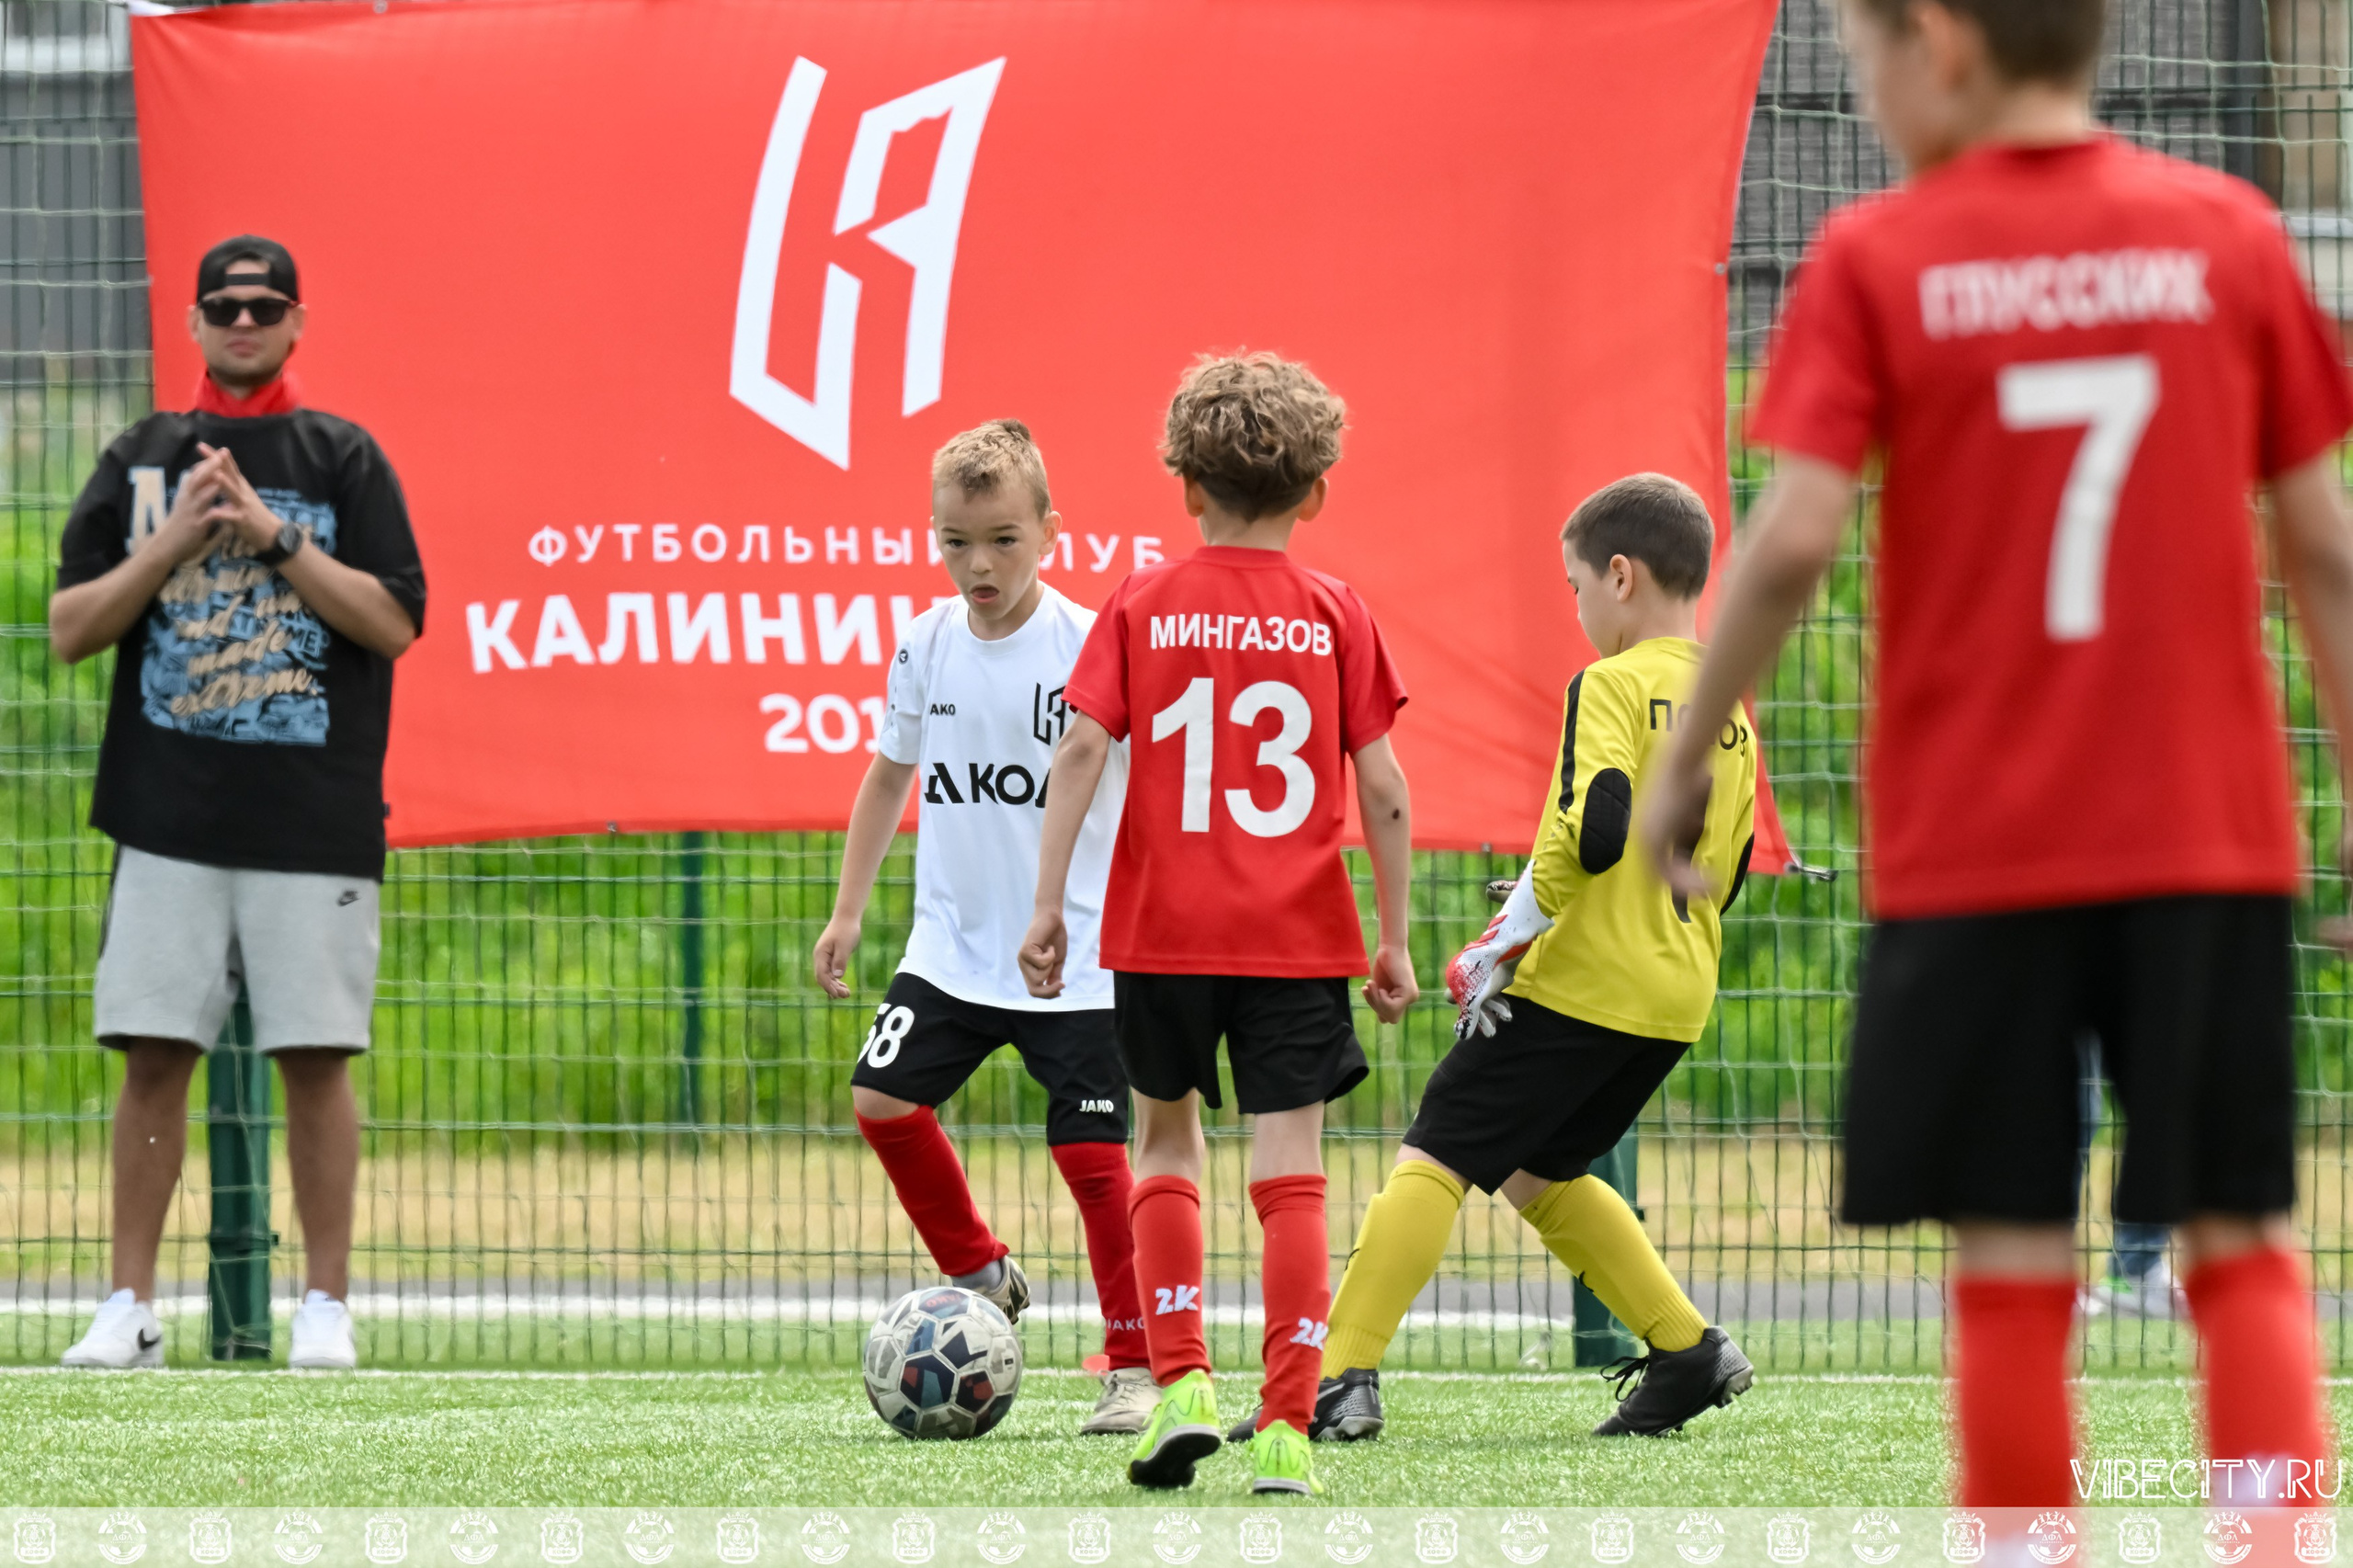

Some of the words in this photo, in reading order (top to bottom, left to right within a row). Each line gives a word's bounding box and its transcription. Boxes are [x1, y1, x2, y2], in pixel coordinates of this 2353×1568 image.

[1996, 352, 2162, 642] 7
[1040, 529, 1165, 573] ЛУБ
[1150, 613, 1332, 656] МИНГАЗОВ
[759, 693, 888, 754] 201
[929, 703, 956, 716] AKO
[1152, 677, 1316, 838] 13
[1079, 1100, 1114, 1113] JAKO
[1155, 1285, 1199, 1315] 2K
[1290, 1317, 1329, 1351] 2K
